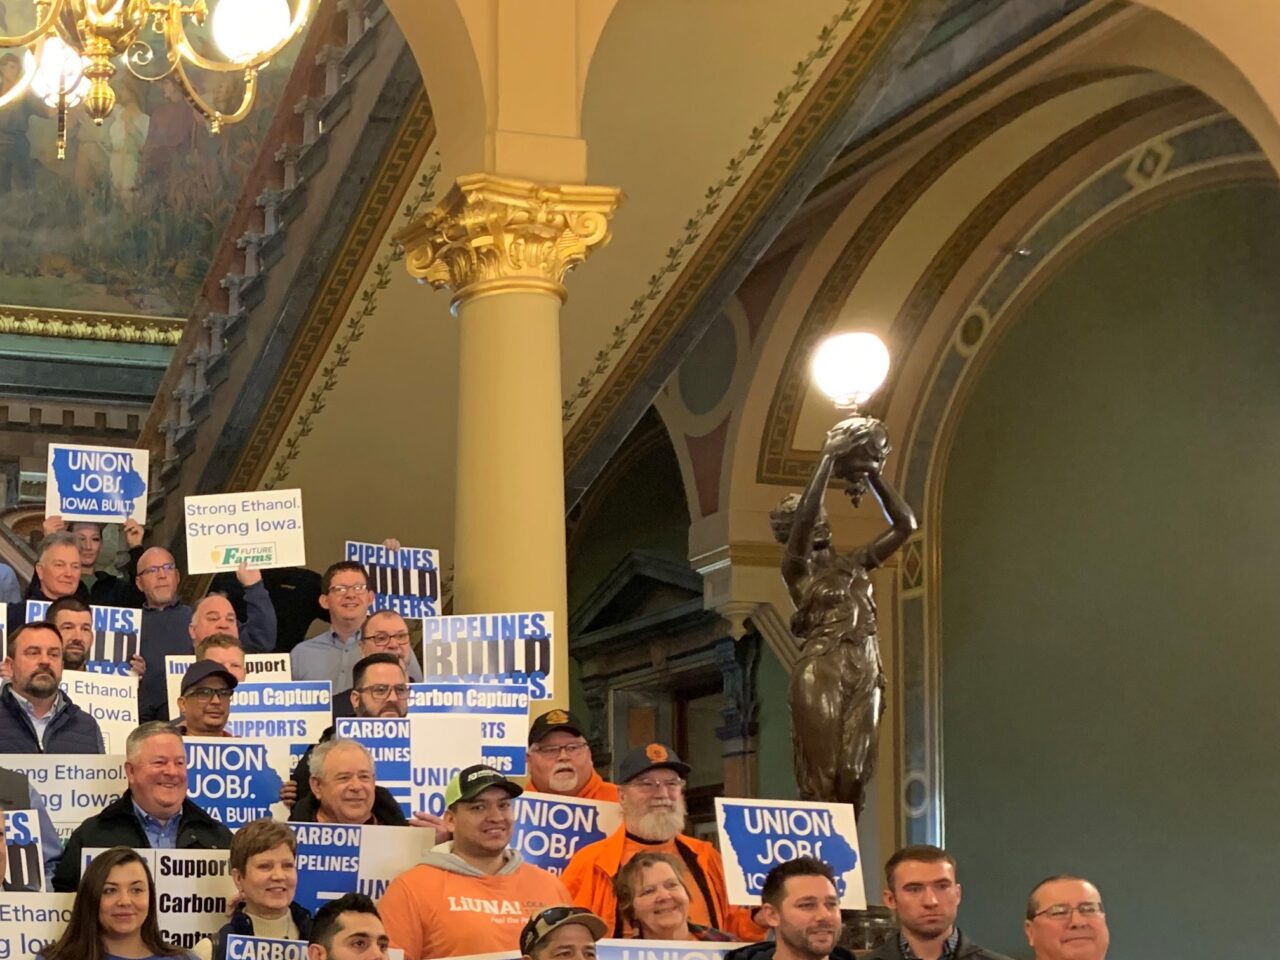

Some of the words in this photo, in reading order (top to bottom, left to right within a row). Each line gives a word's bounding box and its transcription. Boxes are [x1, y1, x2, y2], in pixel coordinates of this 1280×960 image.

[68, 451, 130, 473] UNION
[62, 497, 99, 511] IOWA
[187, 502, 237, 516] Strong
[241, 497, 301, 513] Ethanol.
[188, 521, 249, 537] Strong
[256, 517, 301, 532] Iowa.
[222, 547, 273, 565] Farms
[240, 546, 273, 555] FUTURE
[368, 562, 438, 601] UILD
[75, 680, 136, 699] Ethanol.
[263, 688, 329, 707] Capture
[466, 690, 528, 709] Capture
[338, 721, 410, 738] CARBON
[55, 765, 127, 781] Ethanol.
[744, 808, 831, 837] UNION
[159, 893, 226, 913] Carbon
[448, 896, 522, 915] LiUNA!
